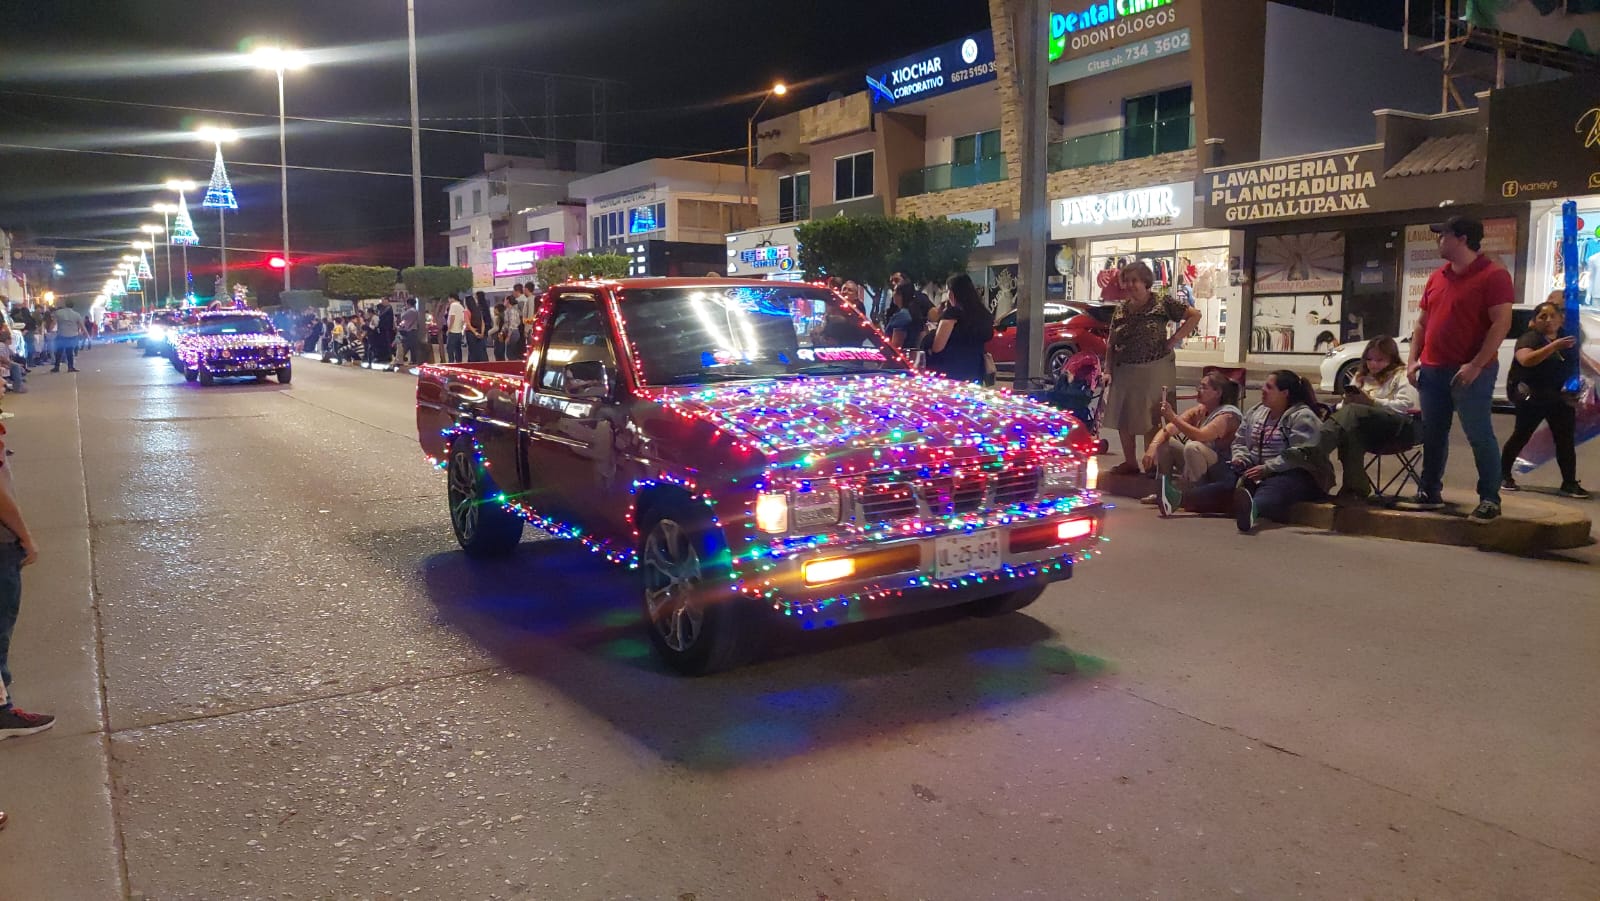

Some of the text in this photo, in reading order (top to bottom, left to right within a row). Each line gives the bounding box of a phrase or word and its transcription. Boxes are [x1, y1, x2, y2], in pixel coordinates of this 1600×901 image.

[1050, 0, 1117, 39] Dental
[1071, 8, 1176, 50] ODONTÓLOGOS
[1087, 57, 1110, 72] Citas
[1125, 44, 1148, 60] 734
[1154, 32, 1189, 54] 3602
[891, 57, 942, 85] XIOCHAR
[893, 76, 944, 99] CORPORATIVO
[951, 68, 969, 83] 6672
[969, 64, 988, 78] 5150
[1211, 171, 1377, 206] PLANCHADURIA
[1212, 155, 1360, 189] LAVANDERIA Y
[1104, 186, 1178, 221] CLOVER
[1225, 192, 1371, 222] GUADALUPANA
[1131, 216, 1172, 229] BOUTIQUE
